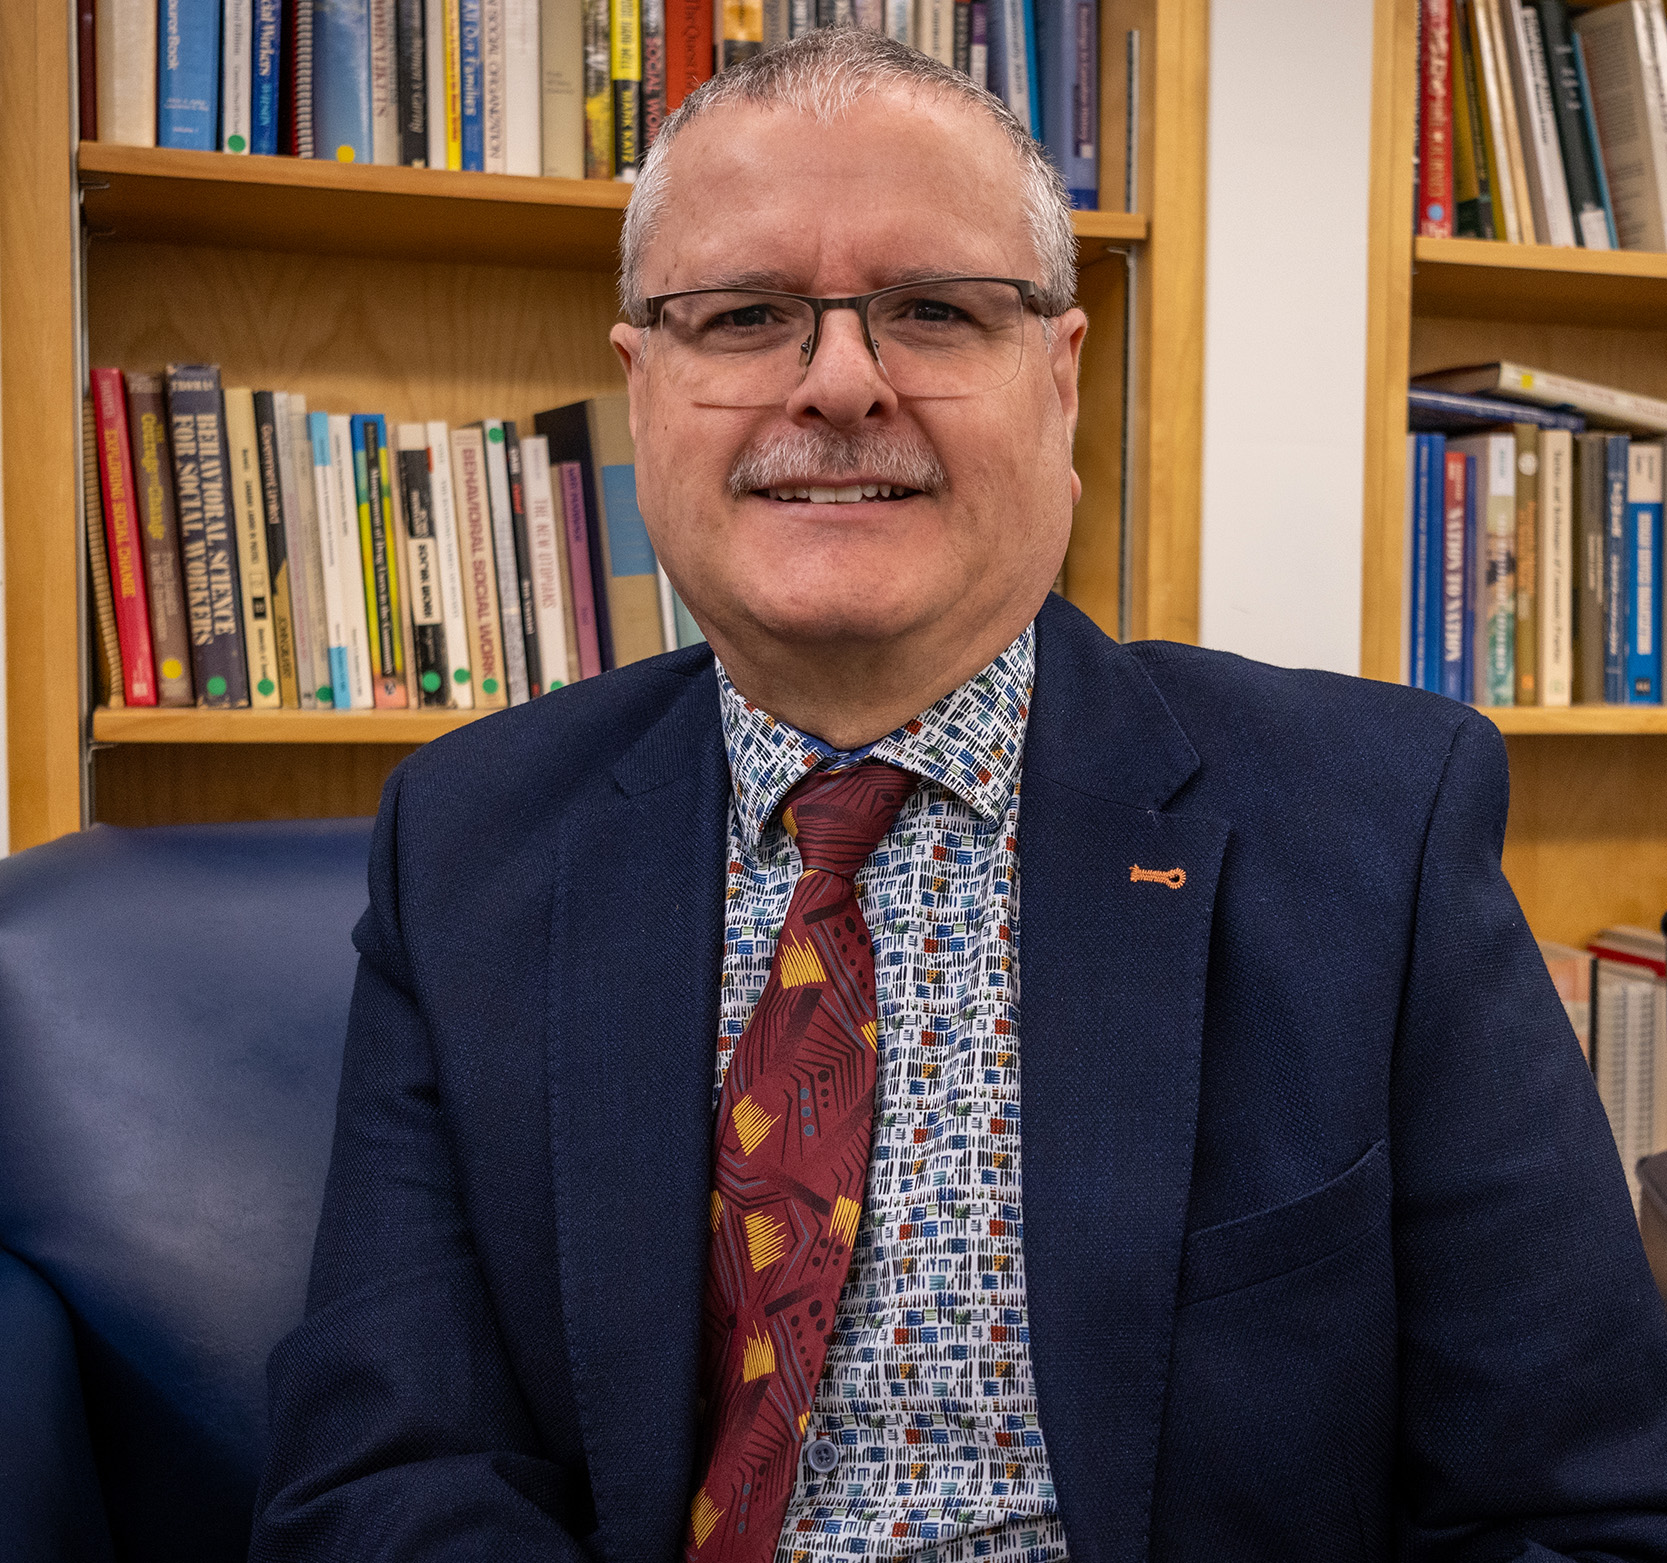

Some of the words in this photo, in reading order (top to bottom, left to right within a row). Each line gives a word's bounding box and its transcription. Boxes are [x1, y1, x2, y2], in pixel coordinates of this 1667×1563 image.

[463, 2, 479, 22] All
[488, 11, 502, 55] SOCIAL
[259, 25, 276, 76] Workers
[463, 25, 479, 53] Our
[683, 25, 701, 67] Quest
[464, 56, 481, 116] Families
[645, 38, 662, 92] SOCIAL
[489, 62, 504, 160] ORGANIZATION
[622, 90, 635, 128] MARK
[621, 130, 635, 163] KATZ
[172, 414, 197, 456] FOR
[260, 424, 277, 487] Government
[104, 429, 124, 500] EXPLORING
[195, 414, 228, 546] BEHAVIORAL
[176, 461, 204, 537] SOCIAL
[370, 468, 381, 526] Management
[462, 448, 484, 556] BEHAVIORAL
[534, 499, 549, 519] THE
[111, 502, 128, 546] SOCIAL
[373, 527, 384, 539] of
[537, 524, 552, 549] NEW
[1445, 508, 1463, 571] NATION
[117, 547, 136, 598] CHANGE
[374, 541, 386, 565] Drug
[185, 540, 214, 646] WORKERS
[209, 549, 237, 636] SCIENCE
[376, 567, 388, 593] Users
[421, 586, 434, 618] WORK
[472, 560, 494, 619] SOCIAL
[538, 553, 556, 609] UTOPIANS
[1445, 573, 1463, 597] TO
[380, 605, 390, 620] the
[1445, 600, 1463, 662] NATION
[381, 622, 393, 675] Community
[478, 625, 498, 679] WORK
